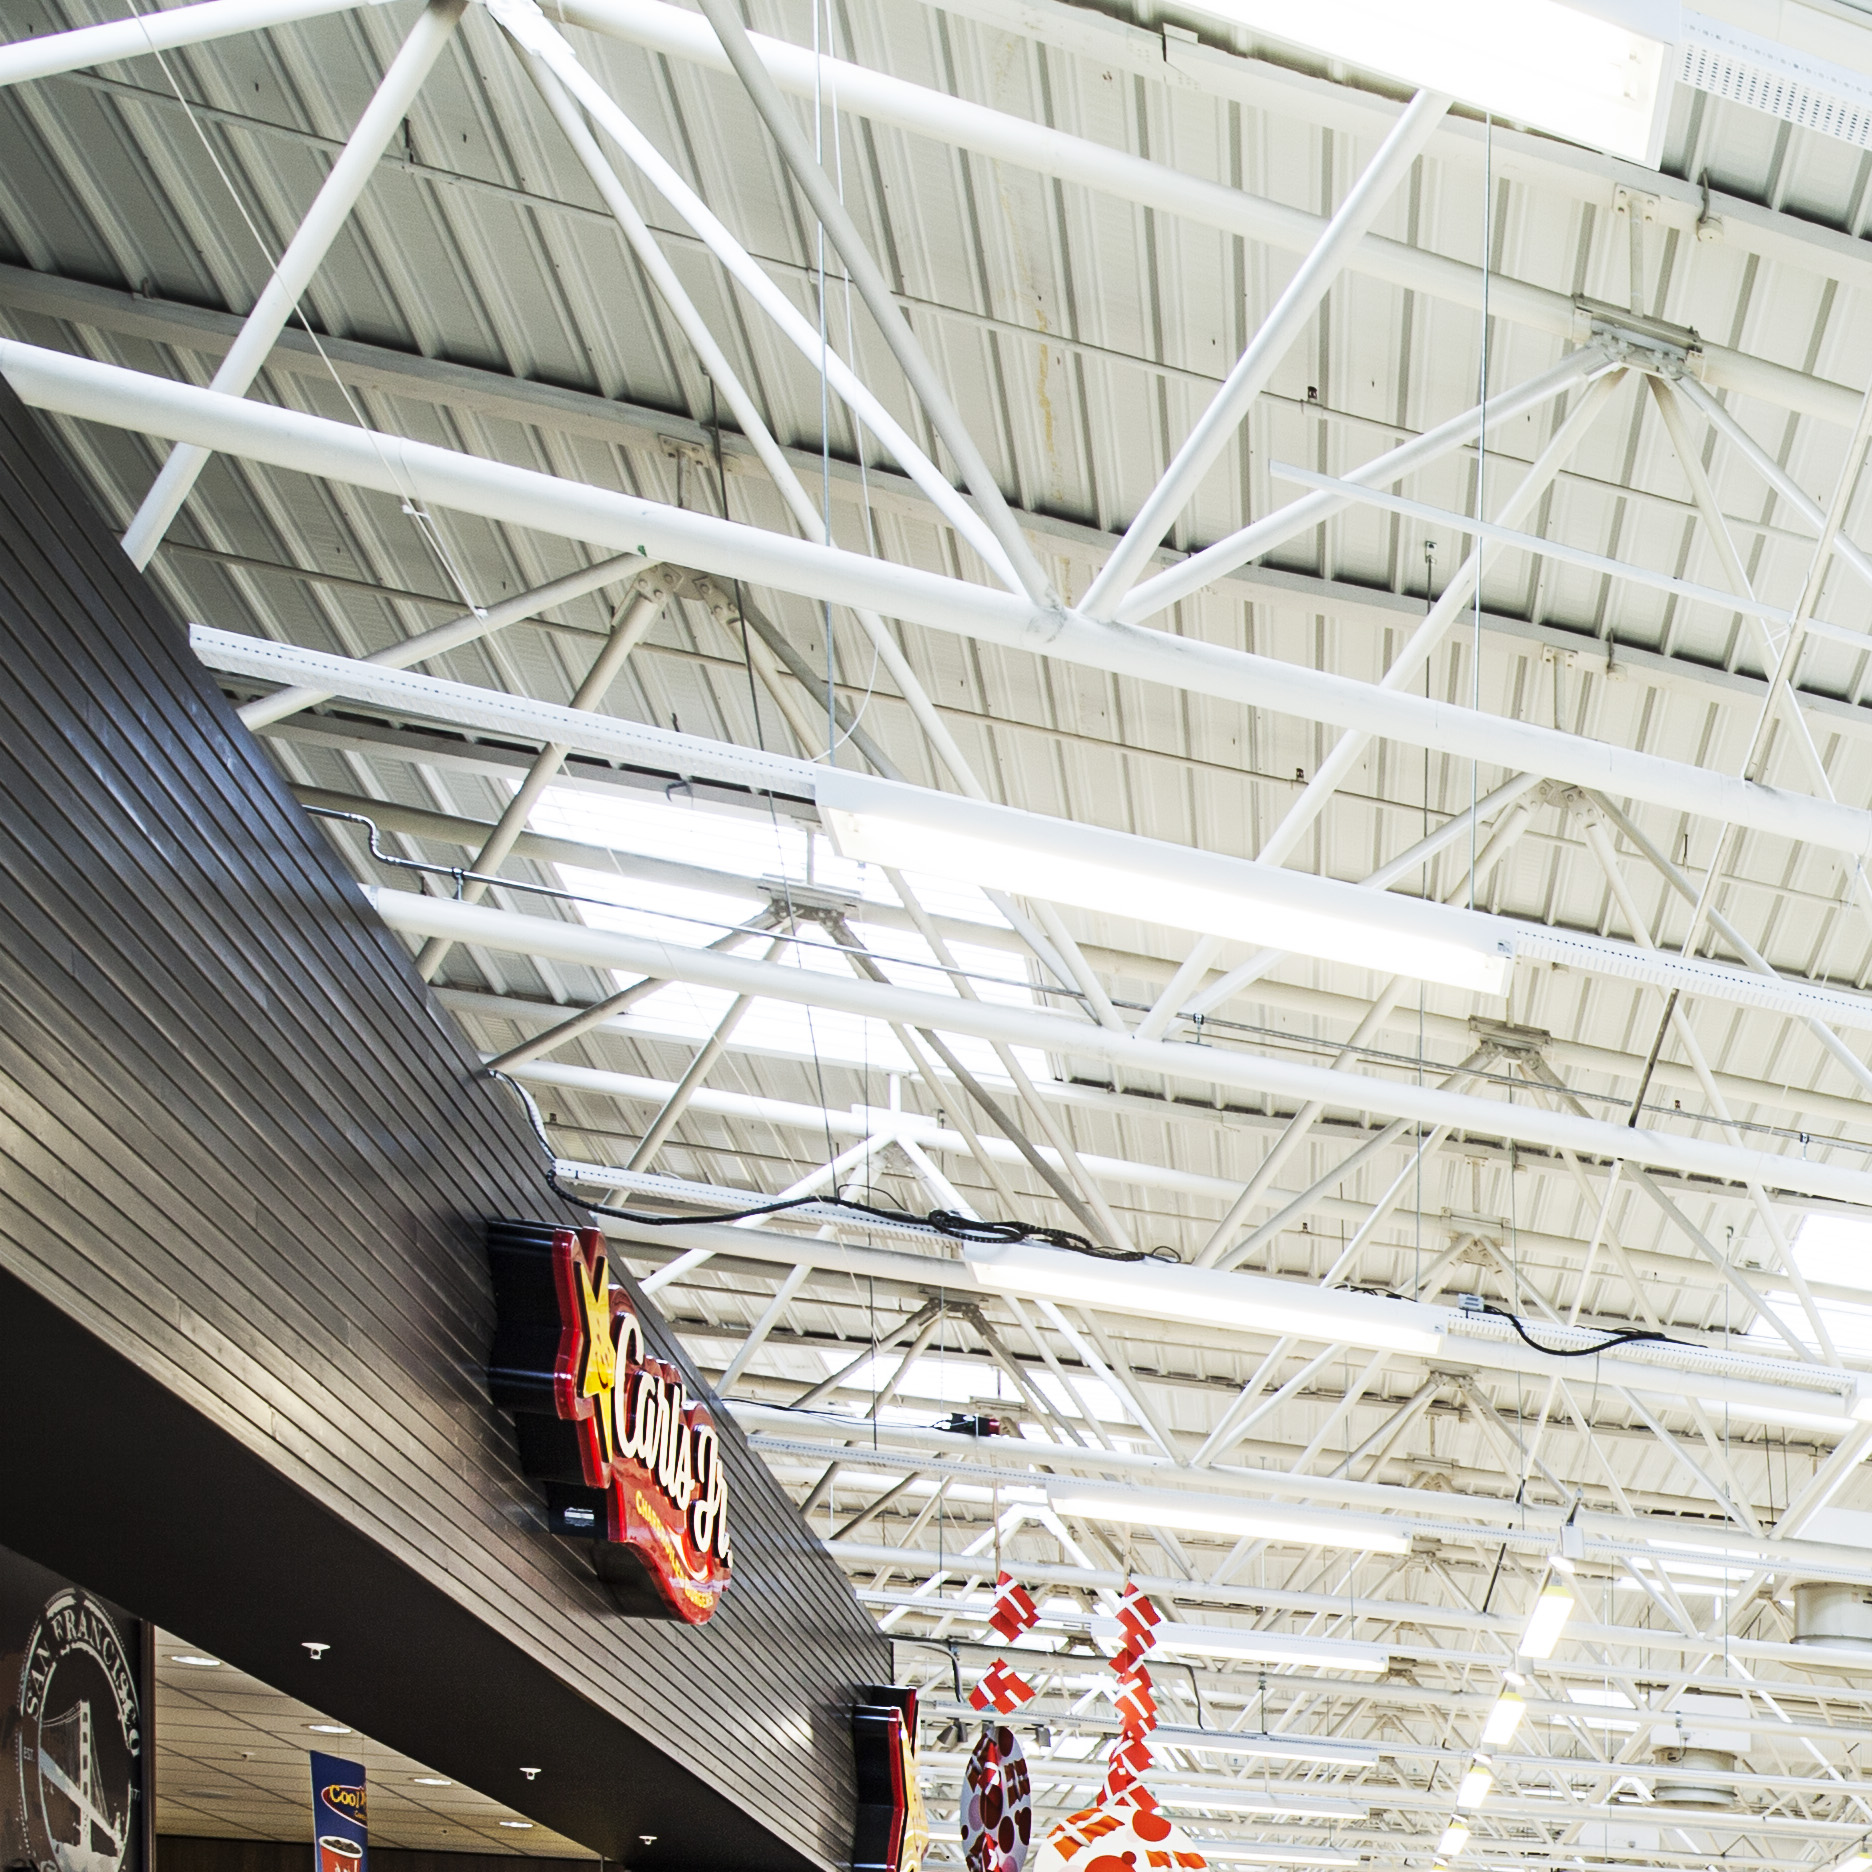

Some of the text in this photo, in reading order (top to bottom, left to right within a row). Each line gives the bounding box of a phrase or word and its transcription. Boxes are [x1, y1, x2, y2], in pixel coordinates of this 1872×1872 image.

[614, 1311, 695, 1511] Carl's
[693, 1424, 733, 1568] Jr.
[25, 1641, 54, 1722] SAN
